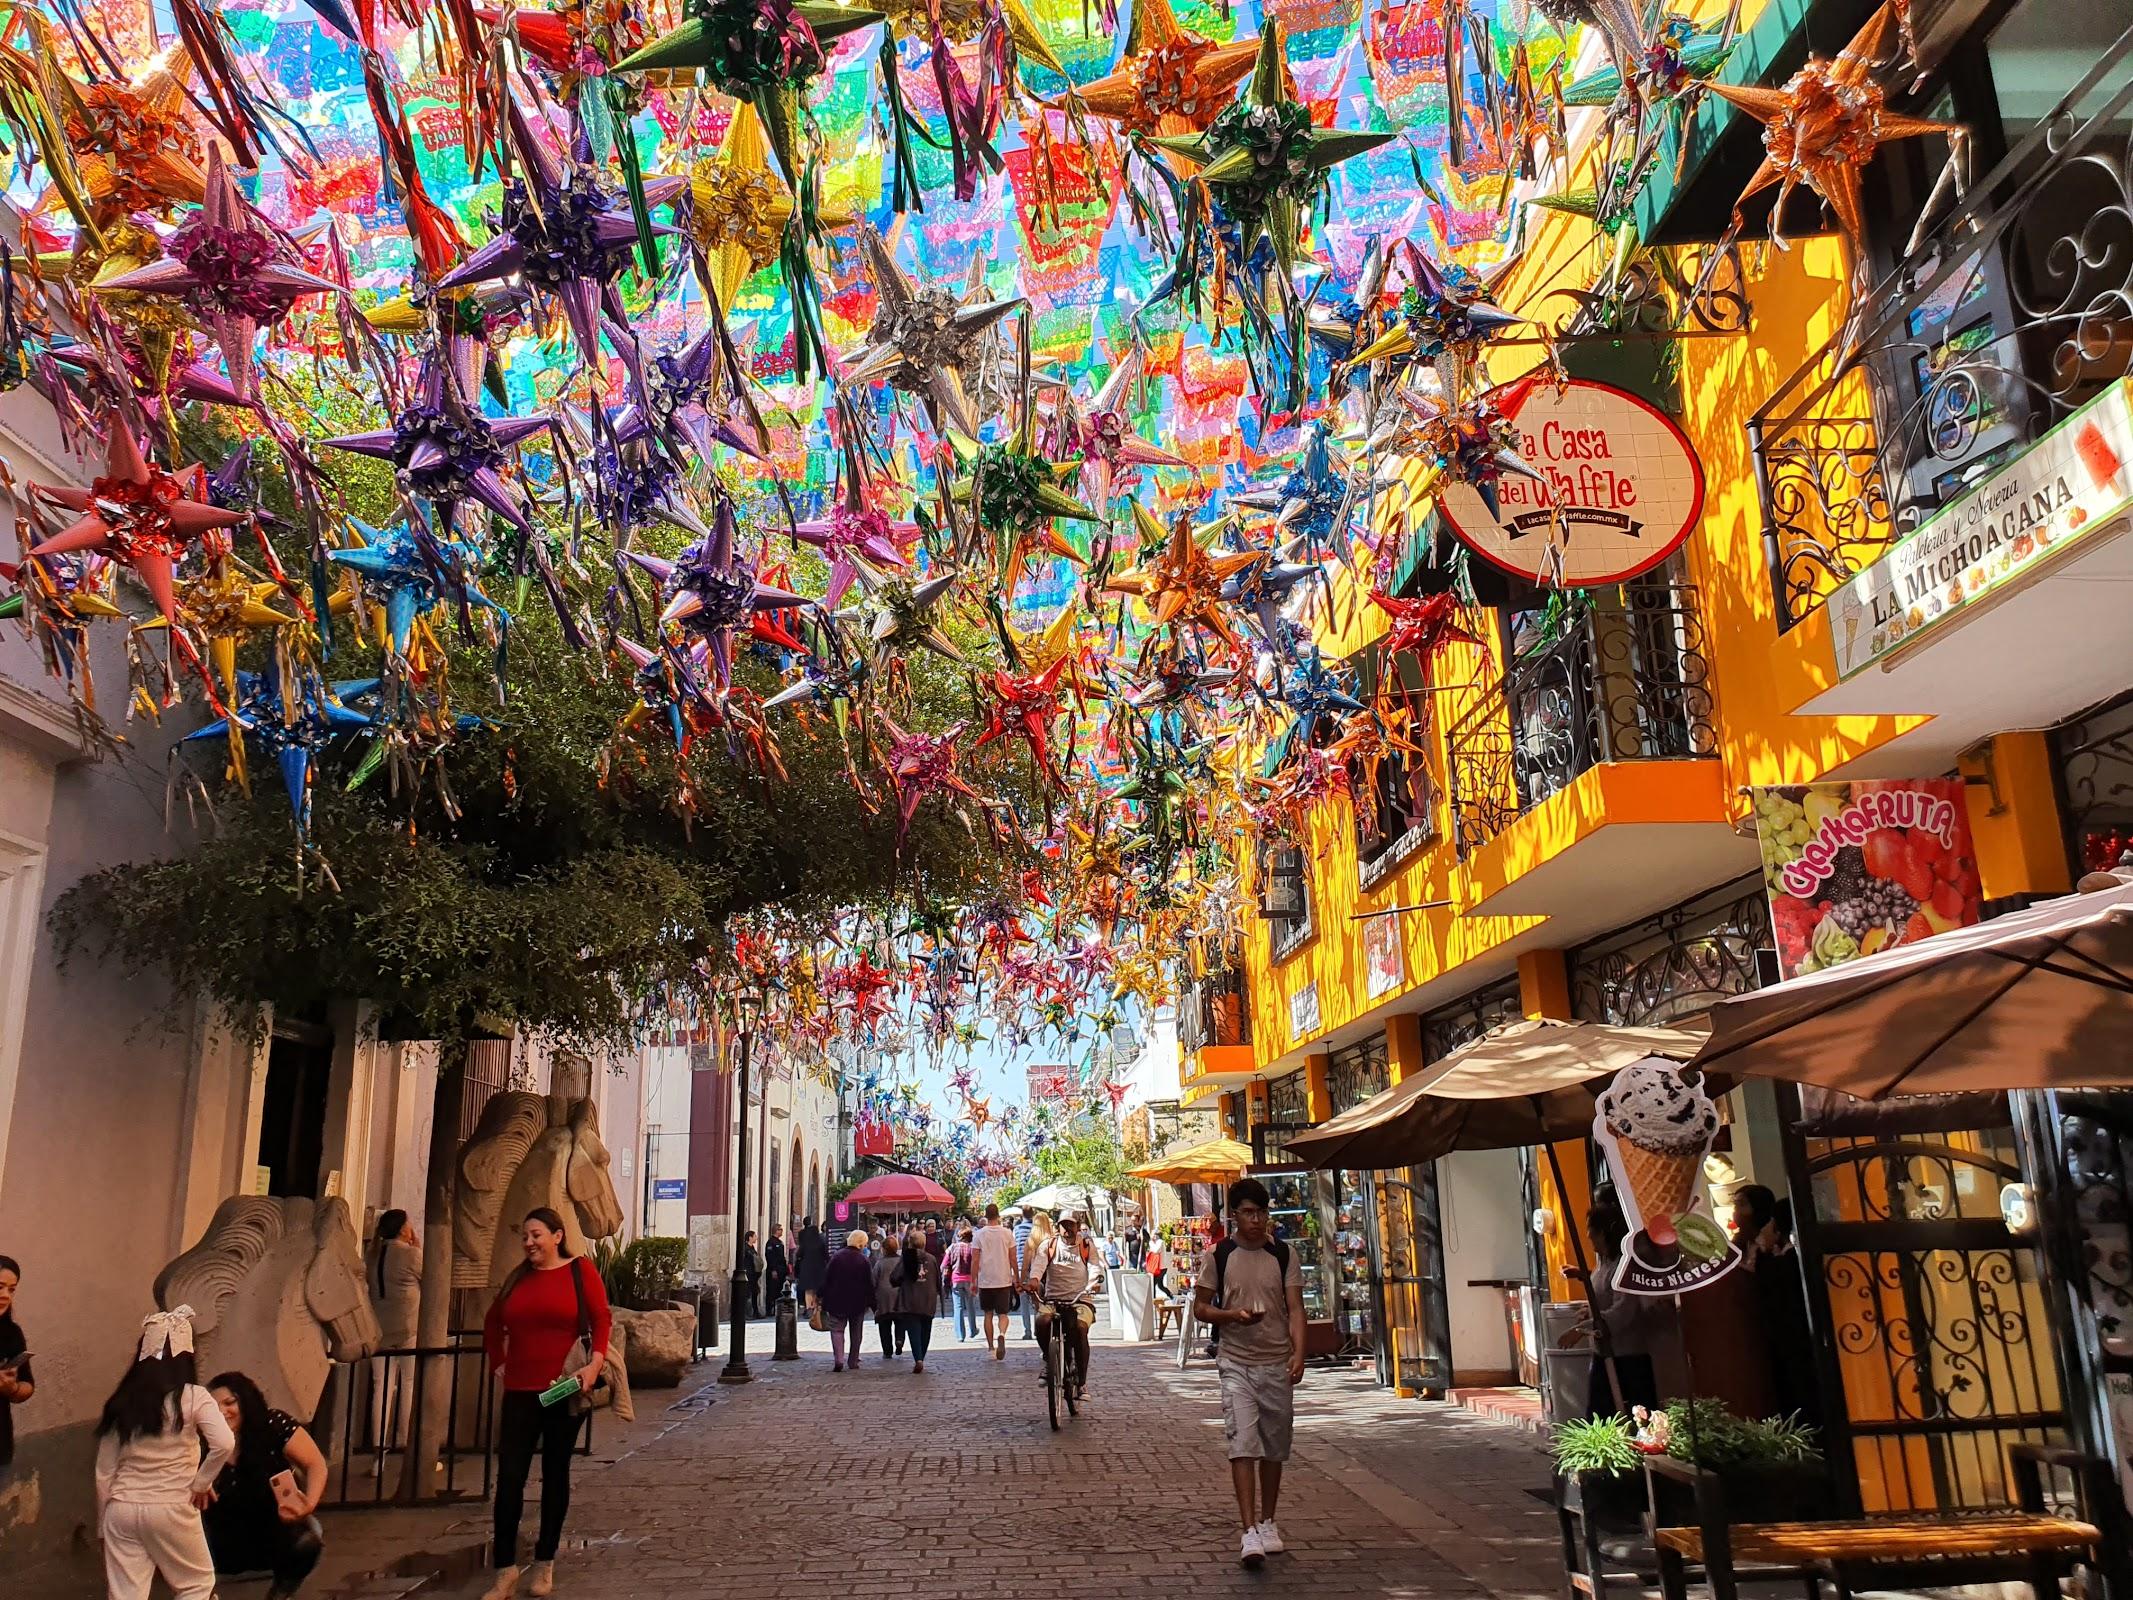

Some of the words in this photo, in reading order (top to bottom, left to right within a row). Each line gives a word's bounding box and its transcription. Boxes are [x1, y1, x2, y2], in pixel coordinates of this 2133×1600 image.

[1543, 420, 1613, 461] Casa
[1499, 482, 1529, 504] del
[1532, 463, 1637, 509] Waffle
[1870, 590, 1902, 627] LA
[1904, 476, 2074, 605] MICHOACANA
[1953, 517, 1961, 543] y
